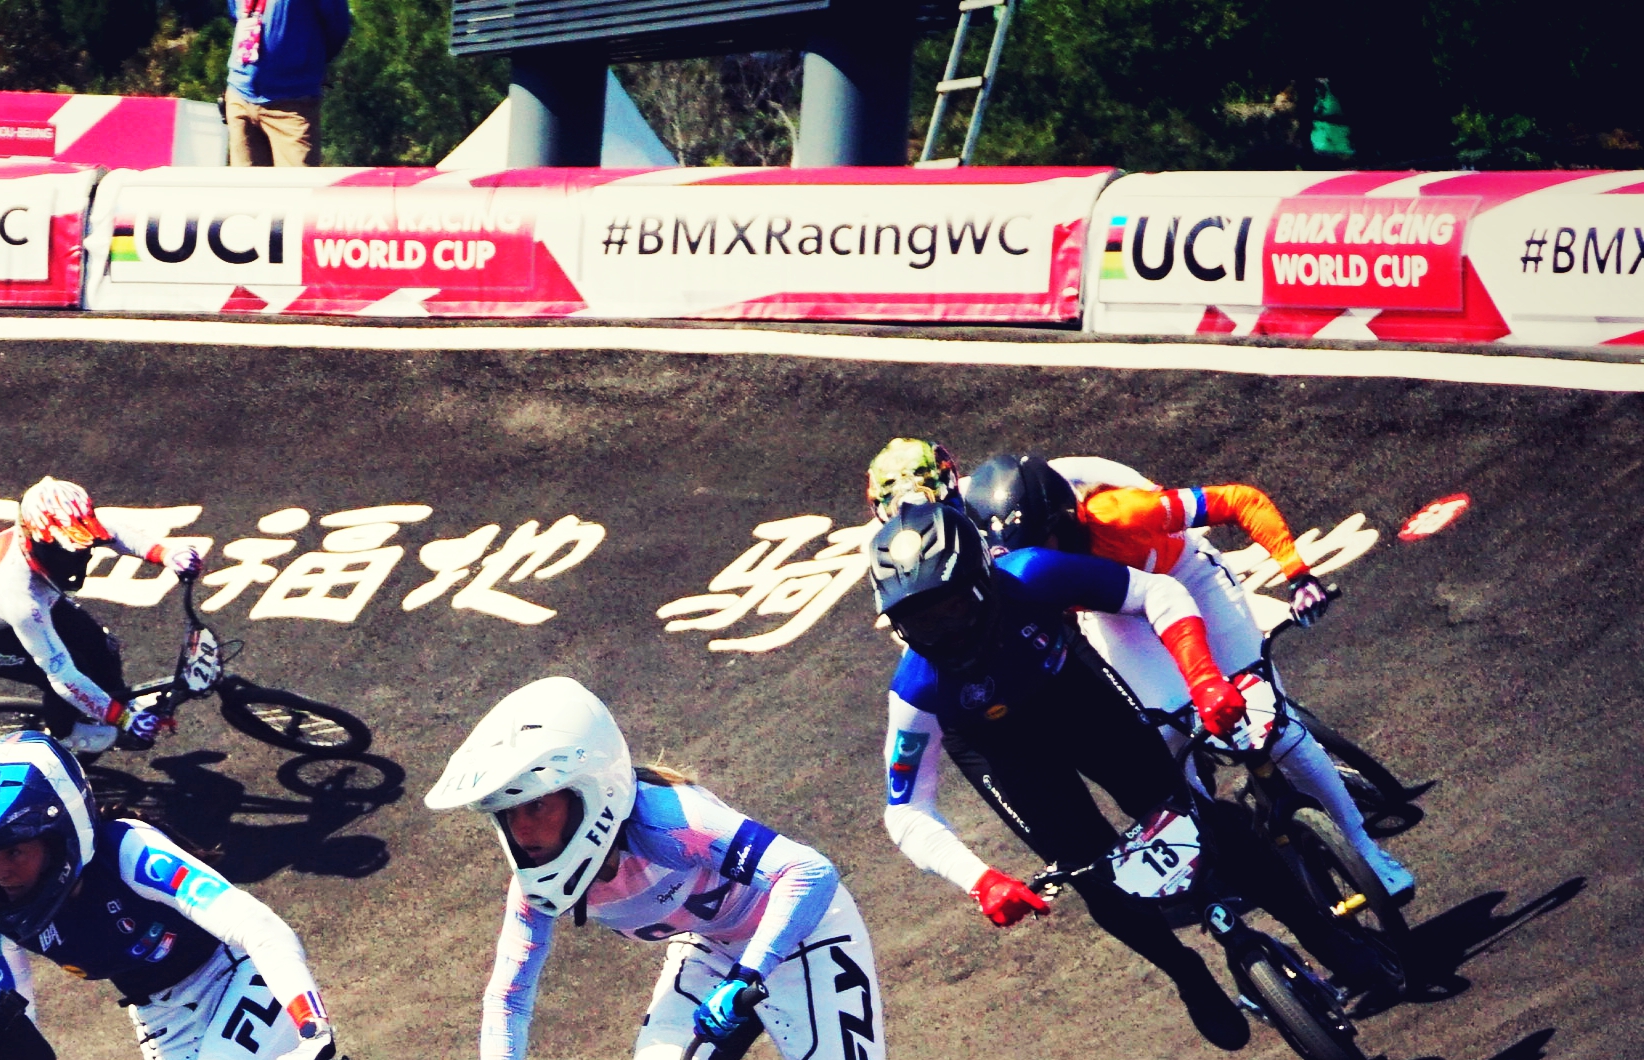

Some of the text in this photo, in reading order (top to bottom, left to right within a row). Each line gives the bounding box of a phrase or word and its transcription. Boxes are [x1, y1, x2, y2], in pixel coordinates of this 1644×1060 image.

[145, 210, 284, 264] UCI
[317, 206, 522, 233] BMX RACING
[1274, 211, 1455, 246] BMX RACING
[315, 239, 495, 270] WORLD CUP
[602, 212, 1032, 269] #BMXRacingWC
[1131, 216, 1252, 282] UCI
[1272, 253, 1428, 288] WORLD CUP
[585, 805, 615, 847] FLY
[1125, 822, 1143, 840] box
[1142, 838, 1180, 878] 13
[656, 880, 686, 905] Rapha
